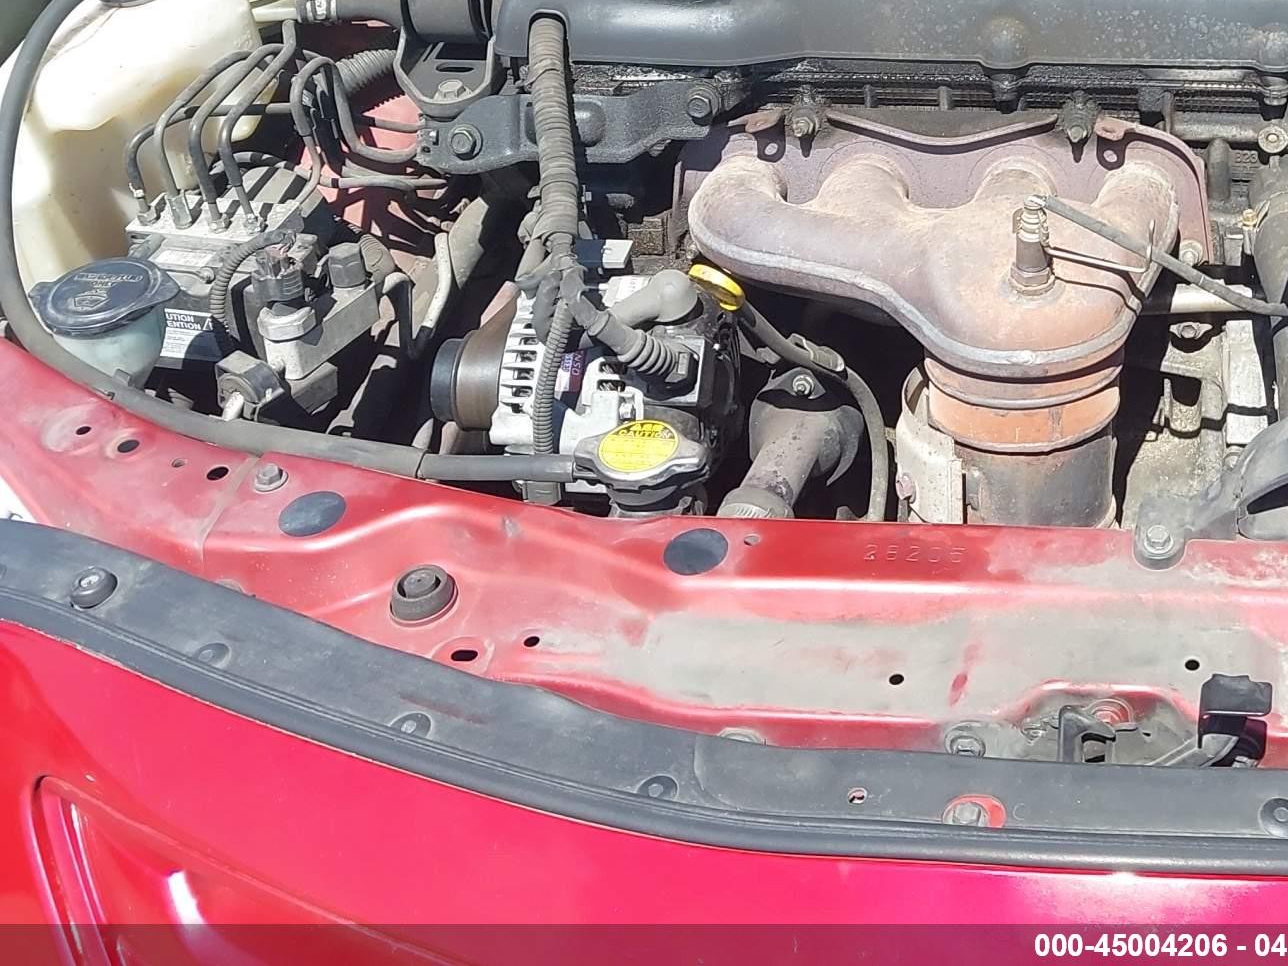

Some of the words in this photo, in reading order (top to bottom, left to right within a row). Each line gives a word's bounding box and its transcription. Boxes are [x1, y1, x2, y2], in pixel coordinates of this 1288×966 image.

[166, 313, 195, 323] UTION
[166, 320, 201, 331] ENTION
[618, 429, 673, 439] CAUTION
